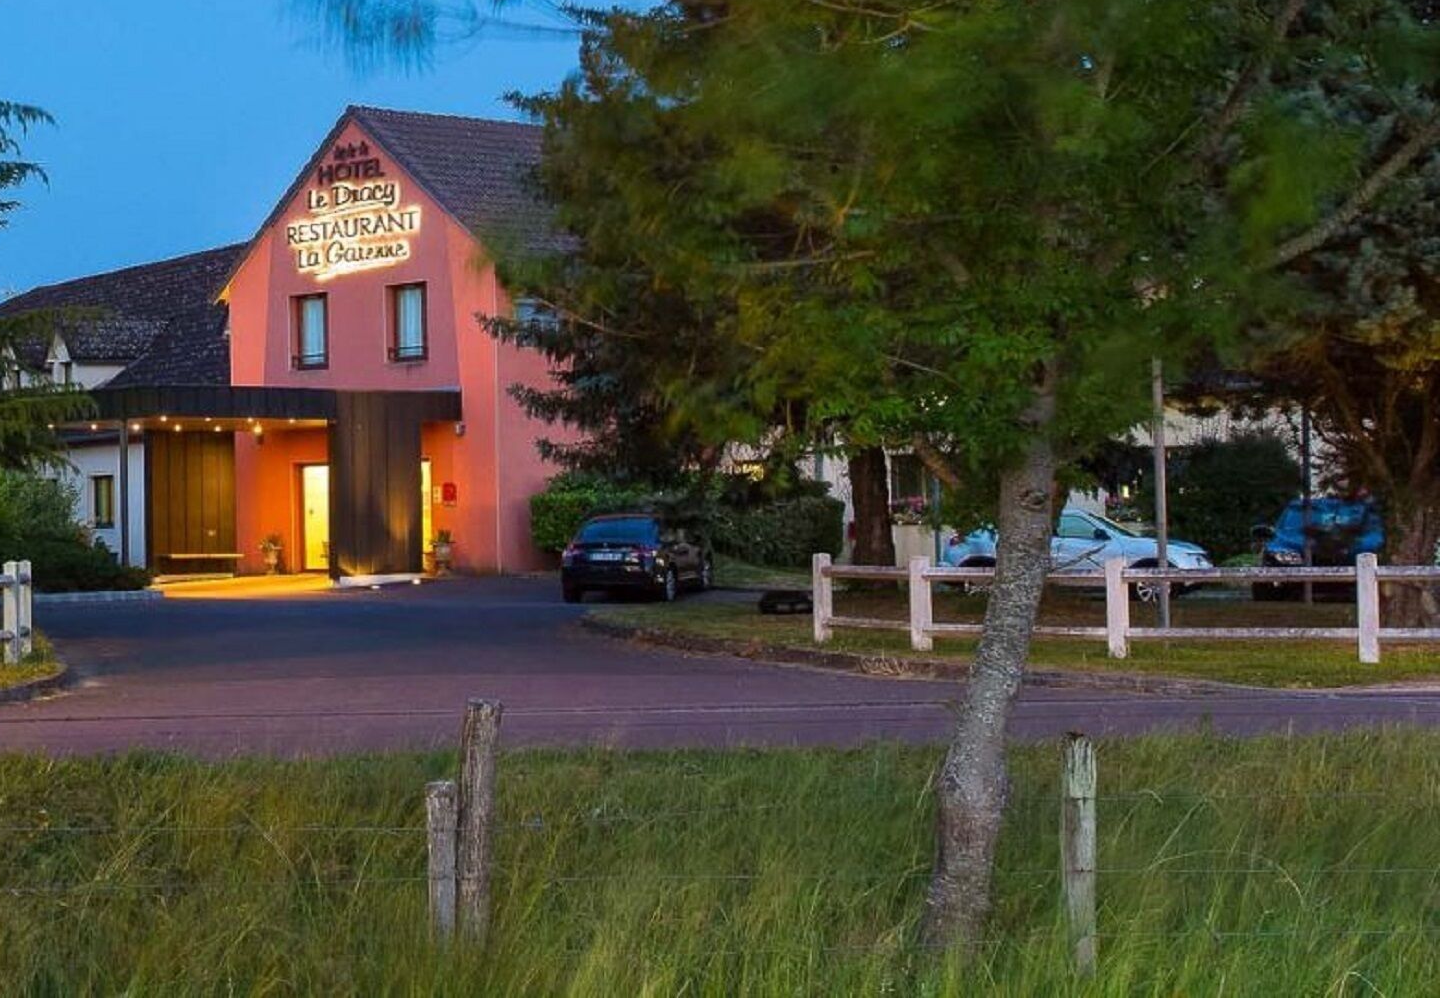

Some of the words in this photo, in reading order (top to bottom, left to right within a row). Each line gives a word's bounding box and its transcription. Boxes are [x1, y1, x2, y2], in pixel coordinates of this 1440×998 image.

[318, 158, 386, 186] HOTEL
[331, 183, 396, 207] Dracy
[286, 211, 419, 245] RESTAURANT
[326, 241, 408, 265] Garenne
